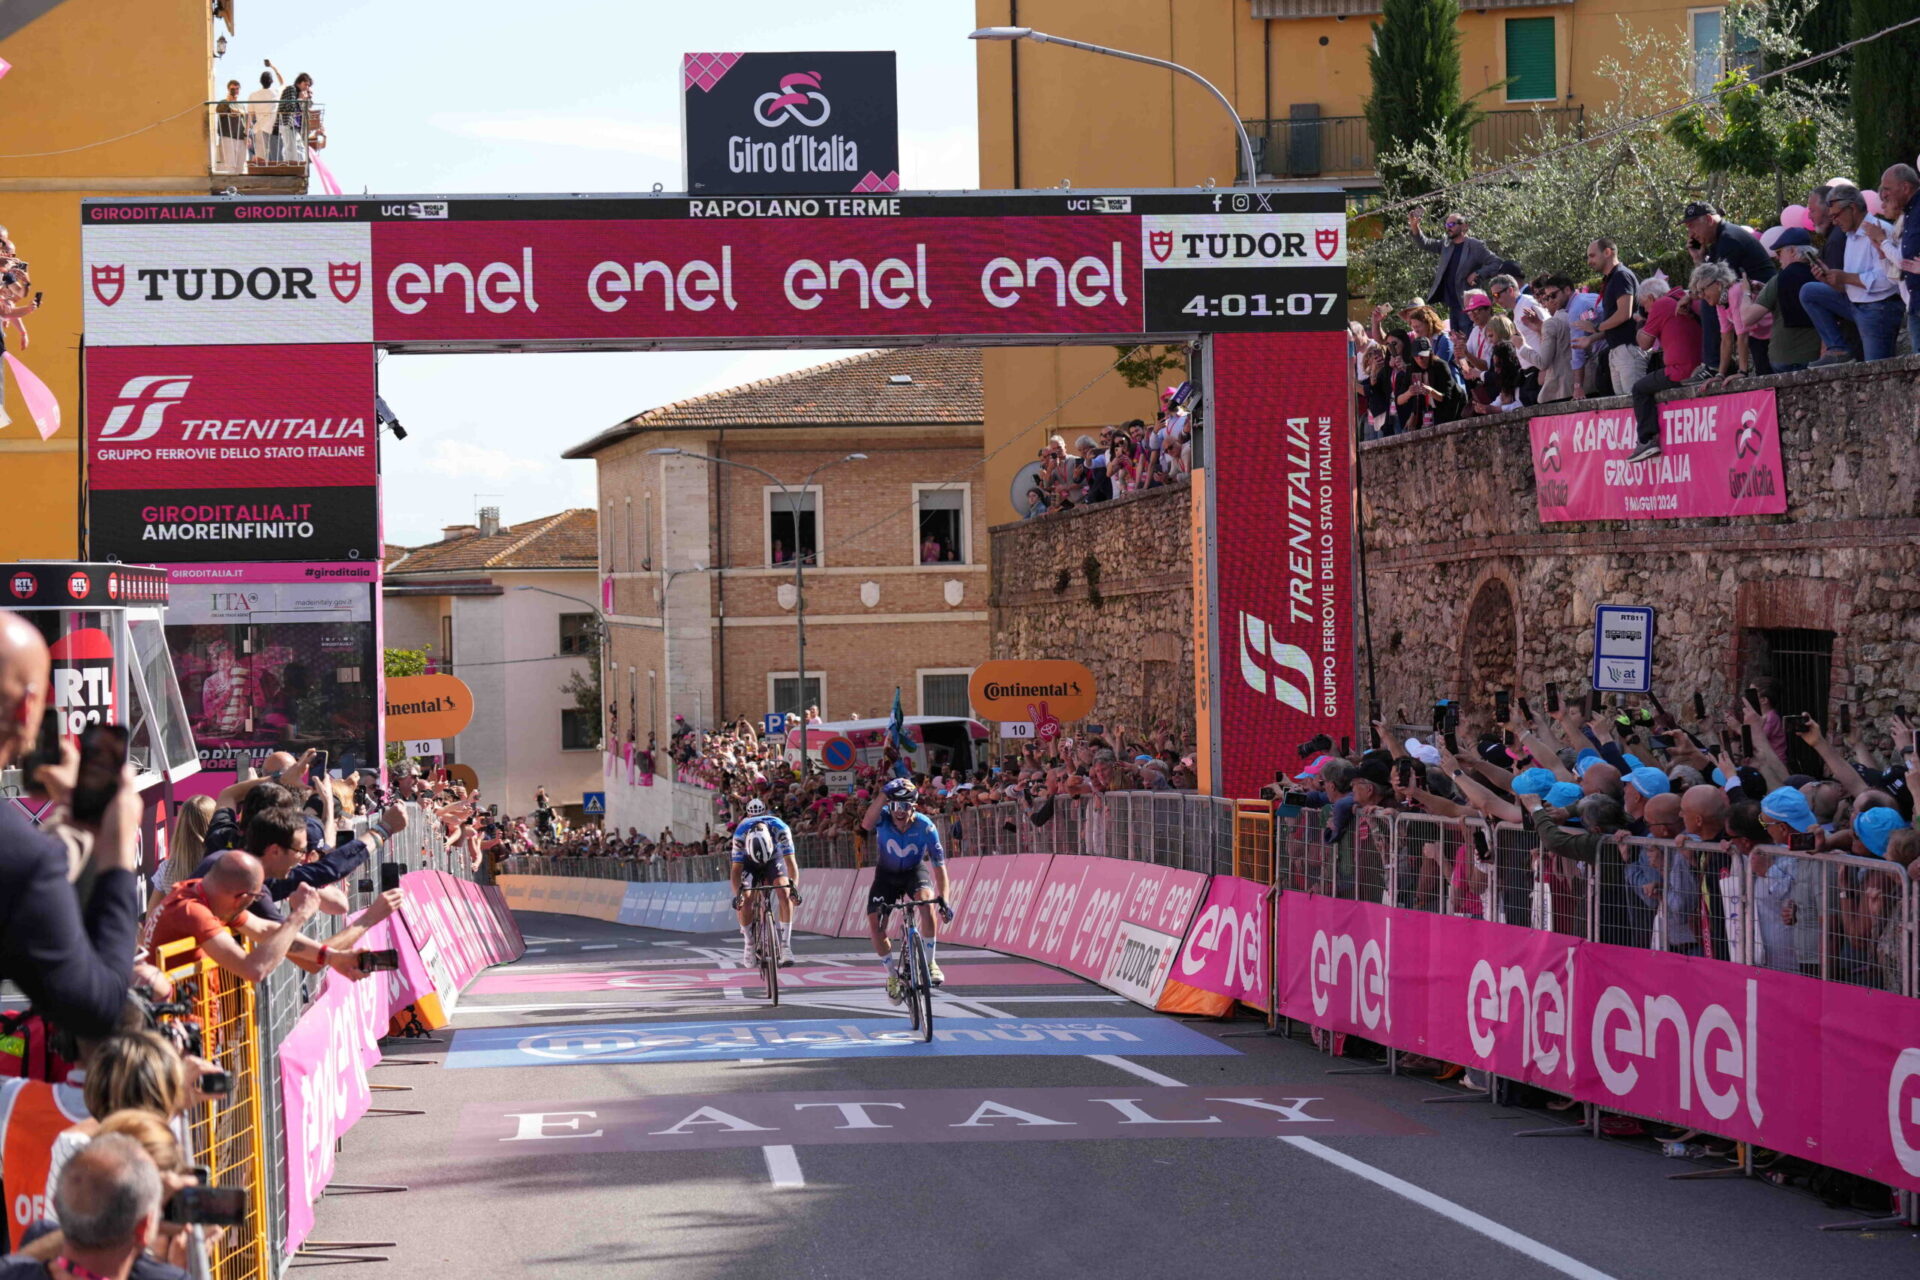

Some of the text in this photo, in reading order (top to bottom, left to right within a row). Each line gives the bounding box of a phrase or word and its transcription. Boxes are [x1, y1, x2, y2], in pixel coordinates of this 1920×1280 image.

[728, 133, 858, 174] Giro d'Italia
[90, 206, 216, 220] GIRODITALIA.IT
[234, 204, 359, 219] GIRODITALIA.IT
[381, 204, 406, 217] UCI
[689, 198, 901, 217] RAPOLANO TERME
[1067, 199, 1091, 212] UCI
[1181, 232, 1307, 259] TUDOR
[138, 267, 316, 301] TUDOR
[387, 247, 540, 315] enel
[587, 245, 738, 313] enel
[783, 243, 932, 310] enel
[981, 241, 1128, 309] enel
[1181, 293, 1338, 317] 4:01:07
[181, 418, 365, 441] TRENITALIA
[1662, 405, 1718, 445] TERME
[97, 445, 365, 461] GRUPPO FERROVIE DELLO STATO ITALIANE
[141, 504, 312, 523] GIRODITALIA.IT
[141, 521, 314, 541] AMOREINFINITO
[1286, 417, 1314, 623] TRENITALIA
[171, 567, 371, 579] GIRODITALIA.IT #giroditalia
[1318, 416, 1337, 718] GRUPPO FERROVIE DELLO STATO ITALIANE
[210, 593, 252, 611] ITA
[54, 666, 113, 707] RTL
[983, 682, 1068, 701] Continental
[1623, 668, 1636, 679] at
[768, 715, 781, 732] P
[1011, 725, 1026, 736] 10
[415, 742, 430, 753] 10
[959, 861, 1010, 939] enel
[993, 861, 1044, 945] enel
[1027, 864, 1090, 955] enel
[1128, 869, 1168, 922] enel
[1157, 877, 1201, 932] enel
[1069, 871, 1136, 969] enel
[1115, 938, 1161, 989] TUDOR
[1181, 892, 1263, 995] enel
[1310, 917, 1392, 1035] enel
[1467, 946, 1577, 1079] enel
[1591, 978, 1764, 1130] enel
